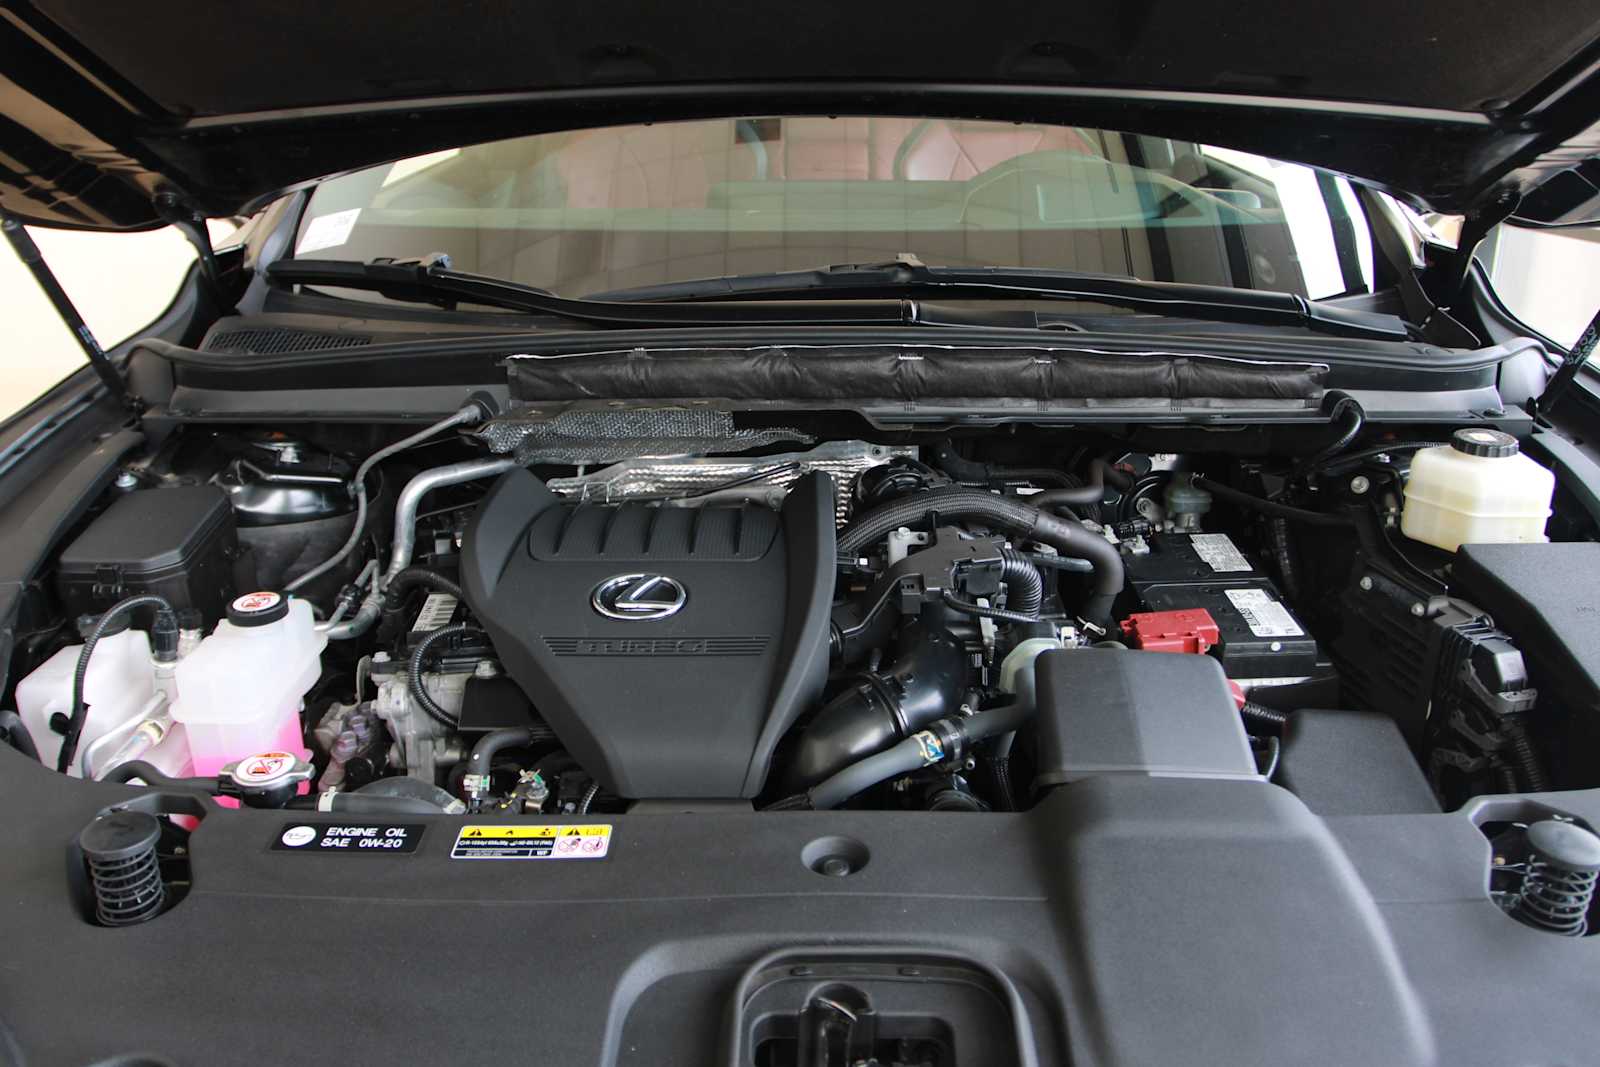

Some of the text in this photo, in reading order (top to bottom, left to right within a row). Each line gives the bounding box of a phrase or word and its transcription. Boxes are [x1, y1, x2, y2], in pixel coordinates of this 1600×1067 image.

[580, 639, 703, 655] TURBO
[326, 826, 408, 838] ENGINE OIL
[320, 837, 403, 849] SAE 0W-20
